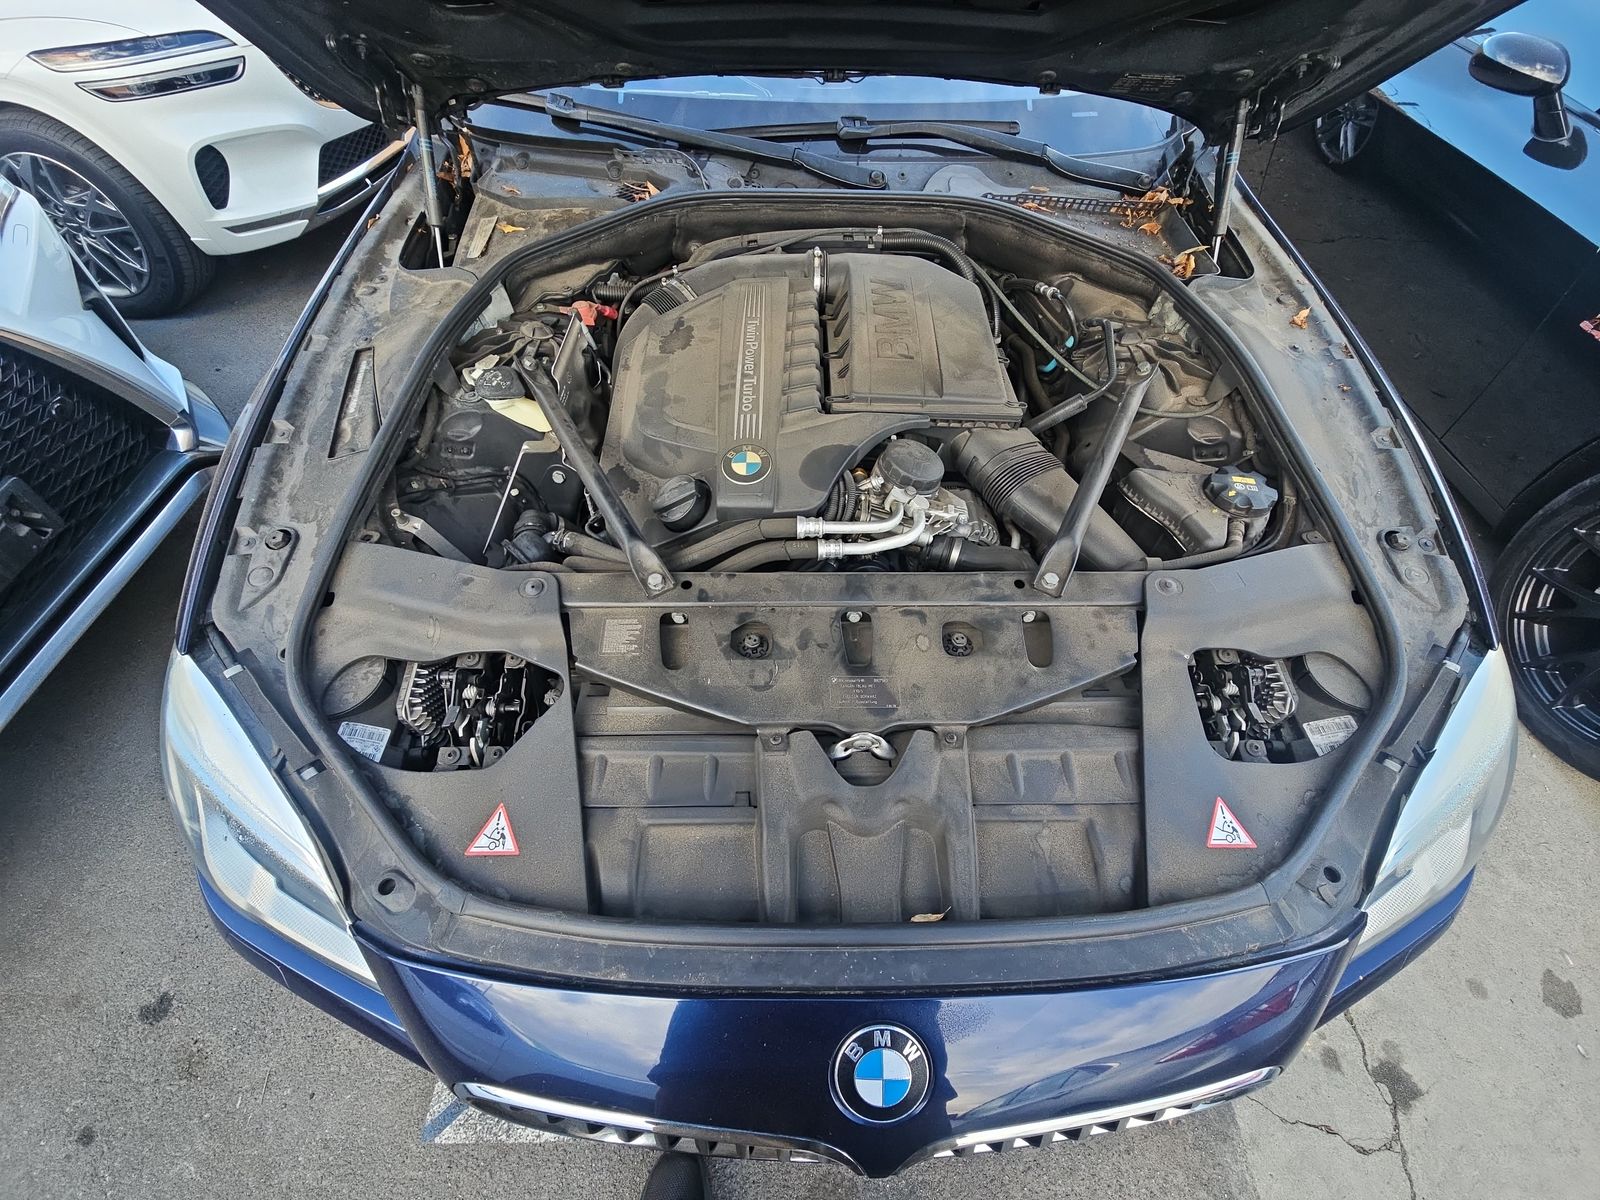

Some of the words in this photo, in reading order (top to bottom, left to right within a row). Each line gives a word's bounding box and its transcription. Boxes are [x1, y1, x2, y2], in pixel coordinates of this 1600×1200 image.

[870, 279, 914, 359] BMW
[744, 318, 760, 375] TwinPower
[742, 376, 757, 411] Turbo
[727, 445, 768, 458] BMW
[844, 1030, 921, 1062] BMW
